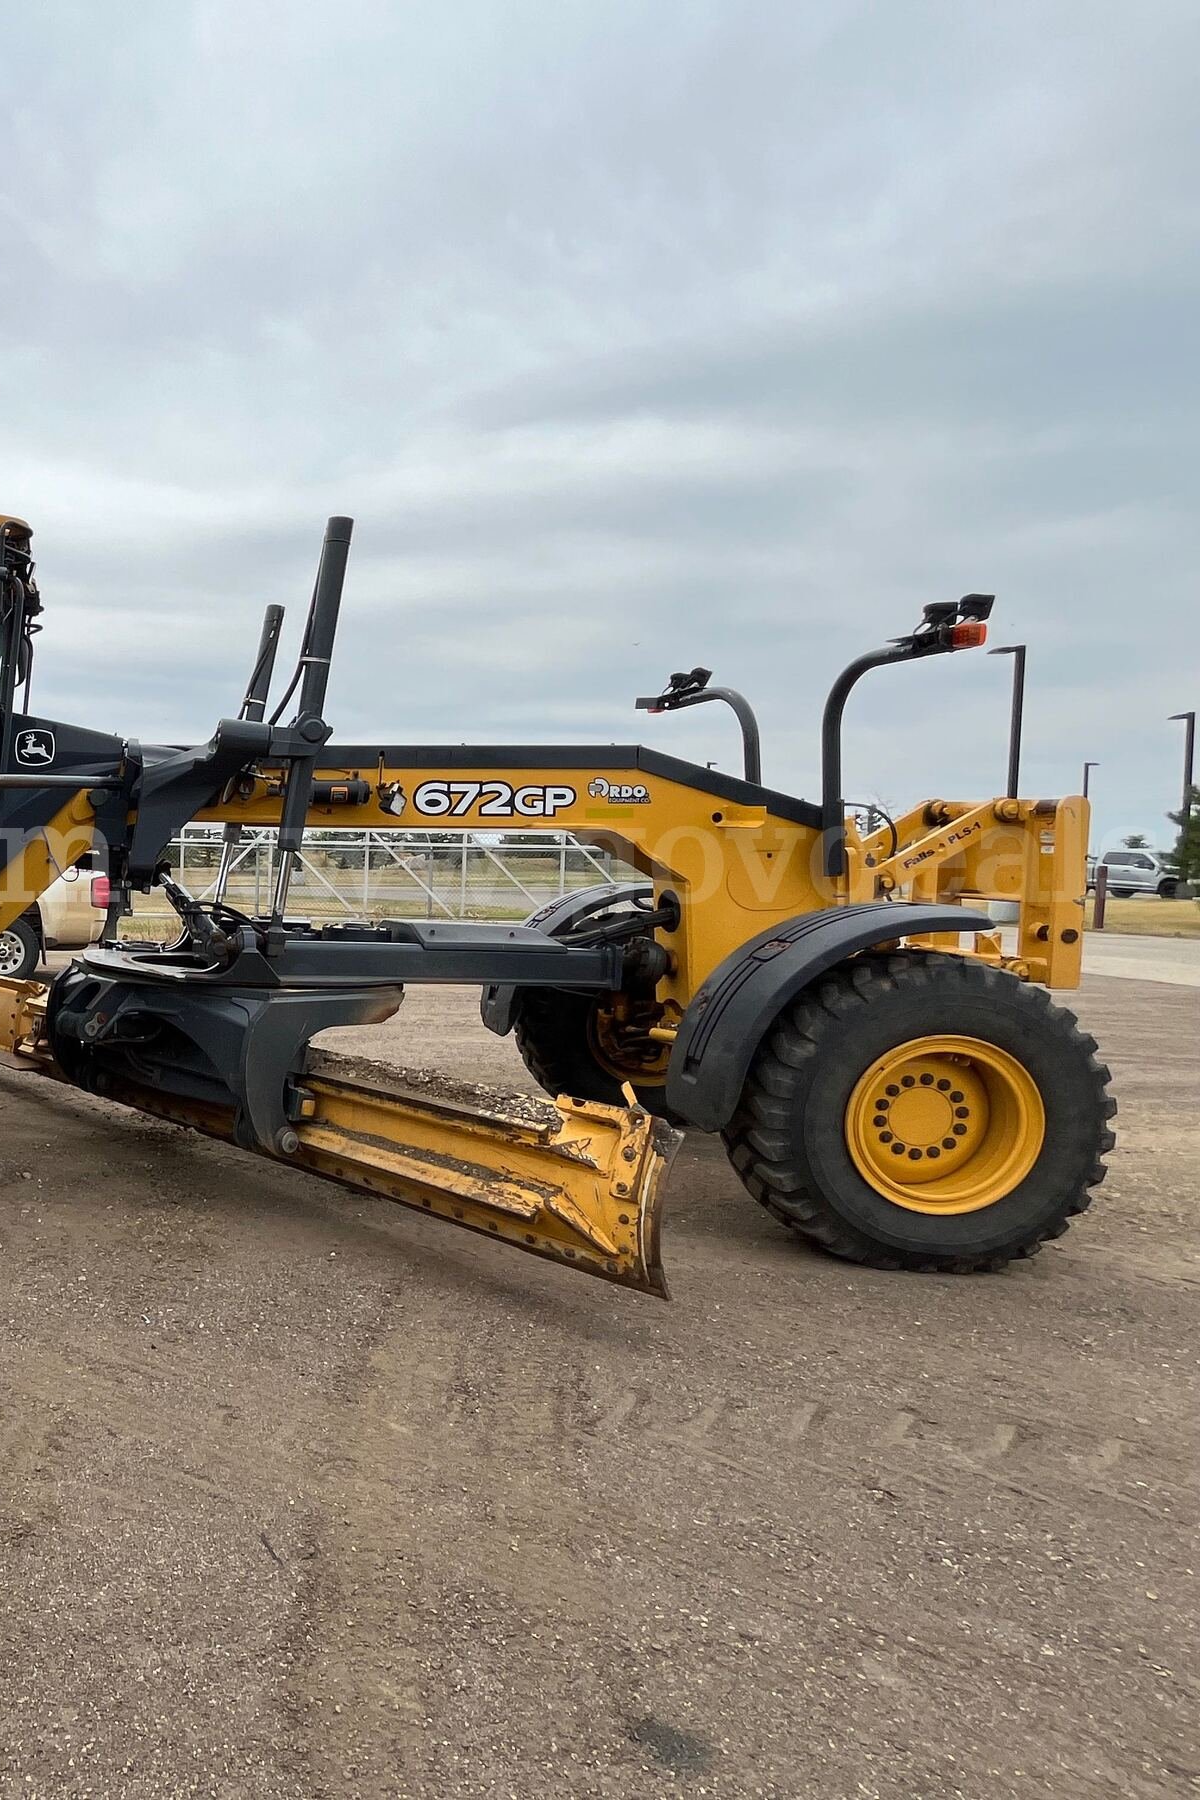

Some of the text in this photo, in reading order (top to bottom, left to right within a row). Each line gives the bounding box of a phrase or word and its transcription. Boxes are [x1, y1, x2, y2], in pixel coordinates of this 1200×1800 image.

[414, 781, 575, 816] 672GP
[903, 821, 981, 869] Falls PLS-1
